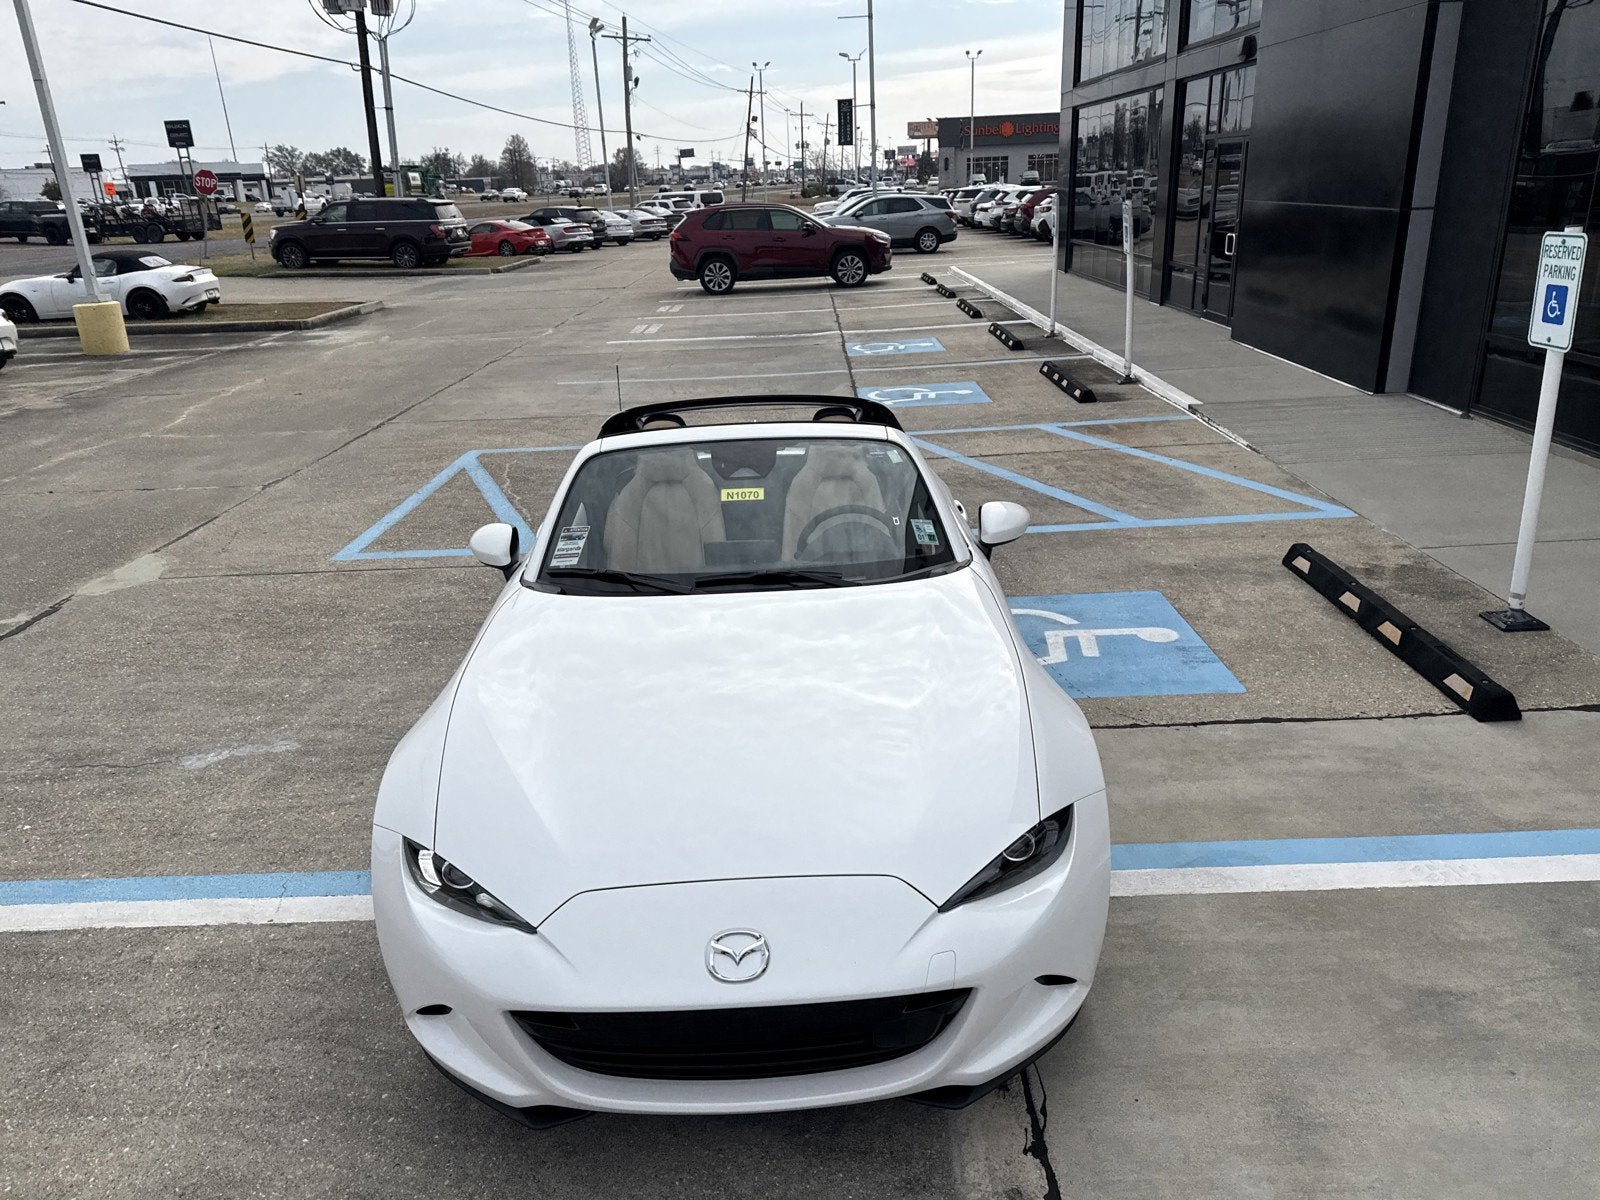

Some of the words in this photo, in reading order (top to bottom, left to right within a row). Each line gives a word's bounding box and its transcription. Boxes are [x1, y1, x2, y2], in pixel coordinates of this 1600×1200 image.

[1015, 121, 1060, 136] Lighting
[195, 176, 216, 188] STOP
[1543, 244, 1581, 260] RESERVED
[1543, 264, 1576, 280] PARKING
[726, 490, 760, 500] N1070
